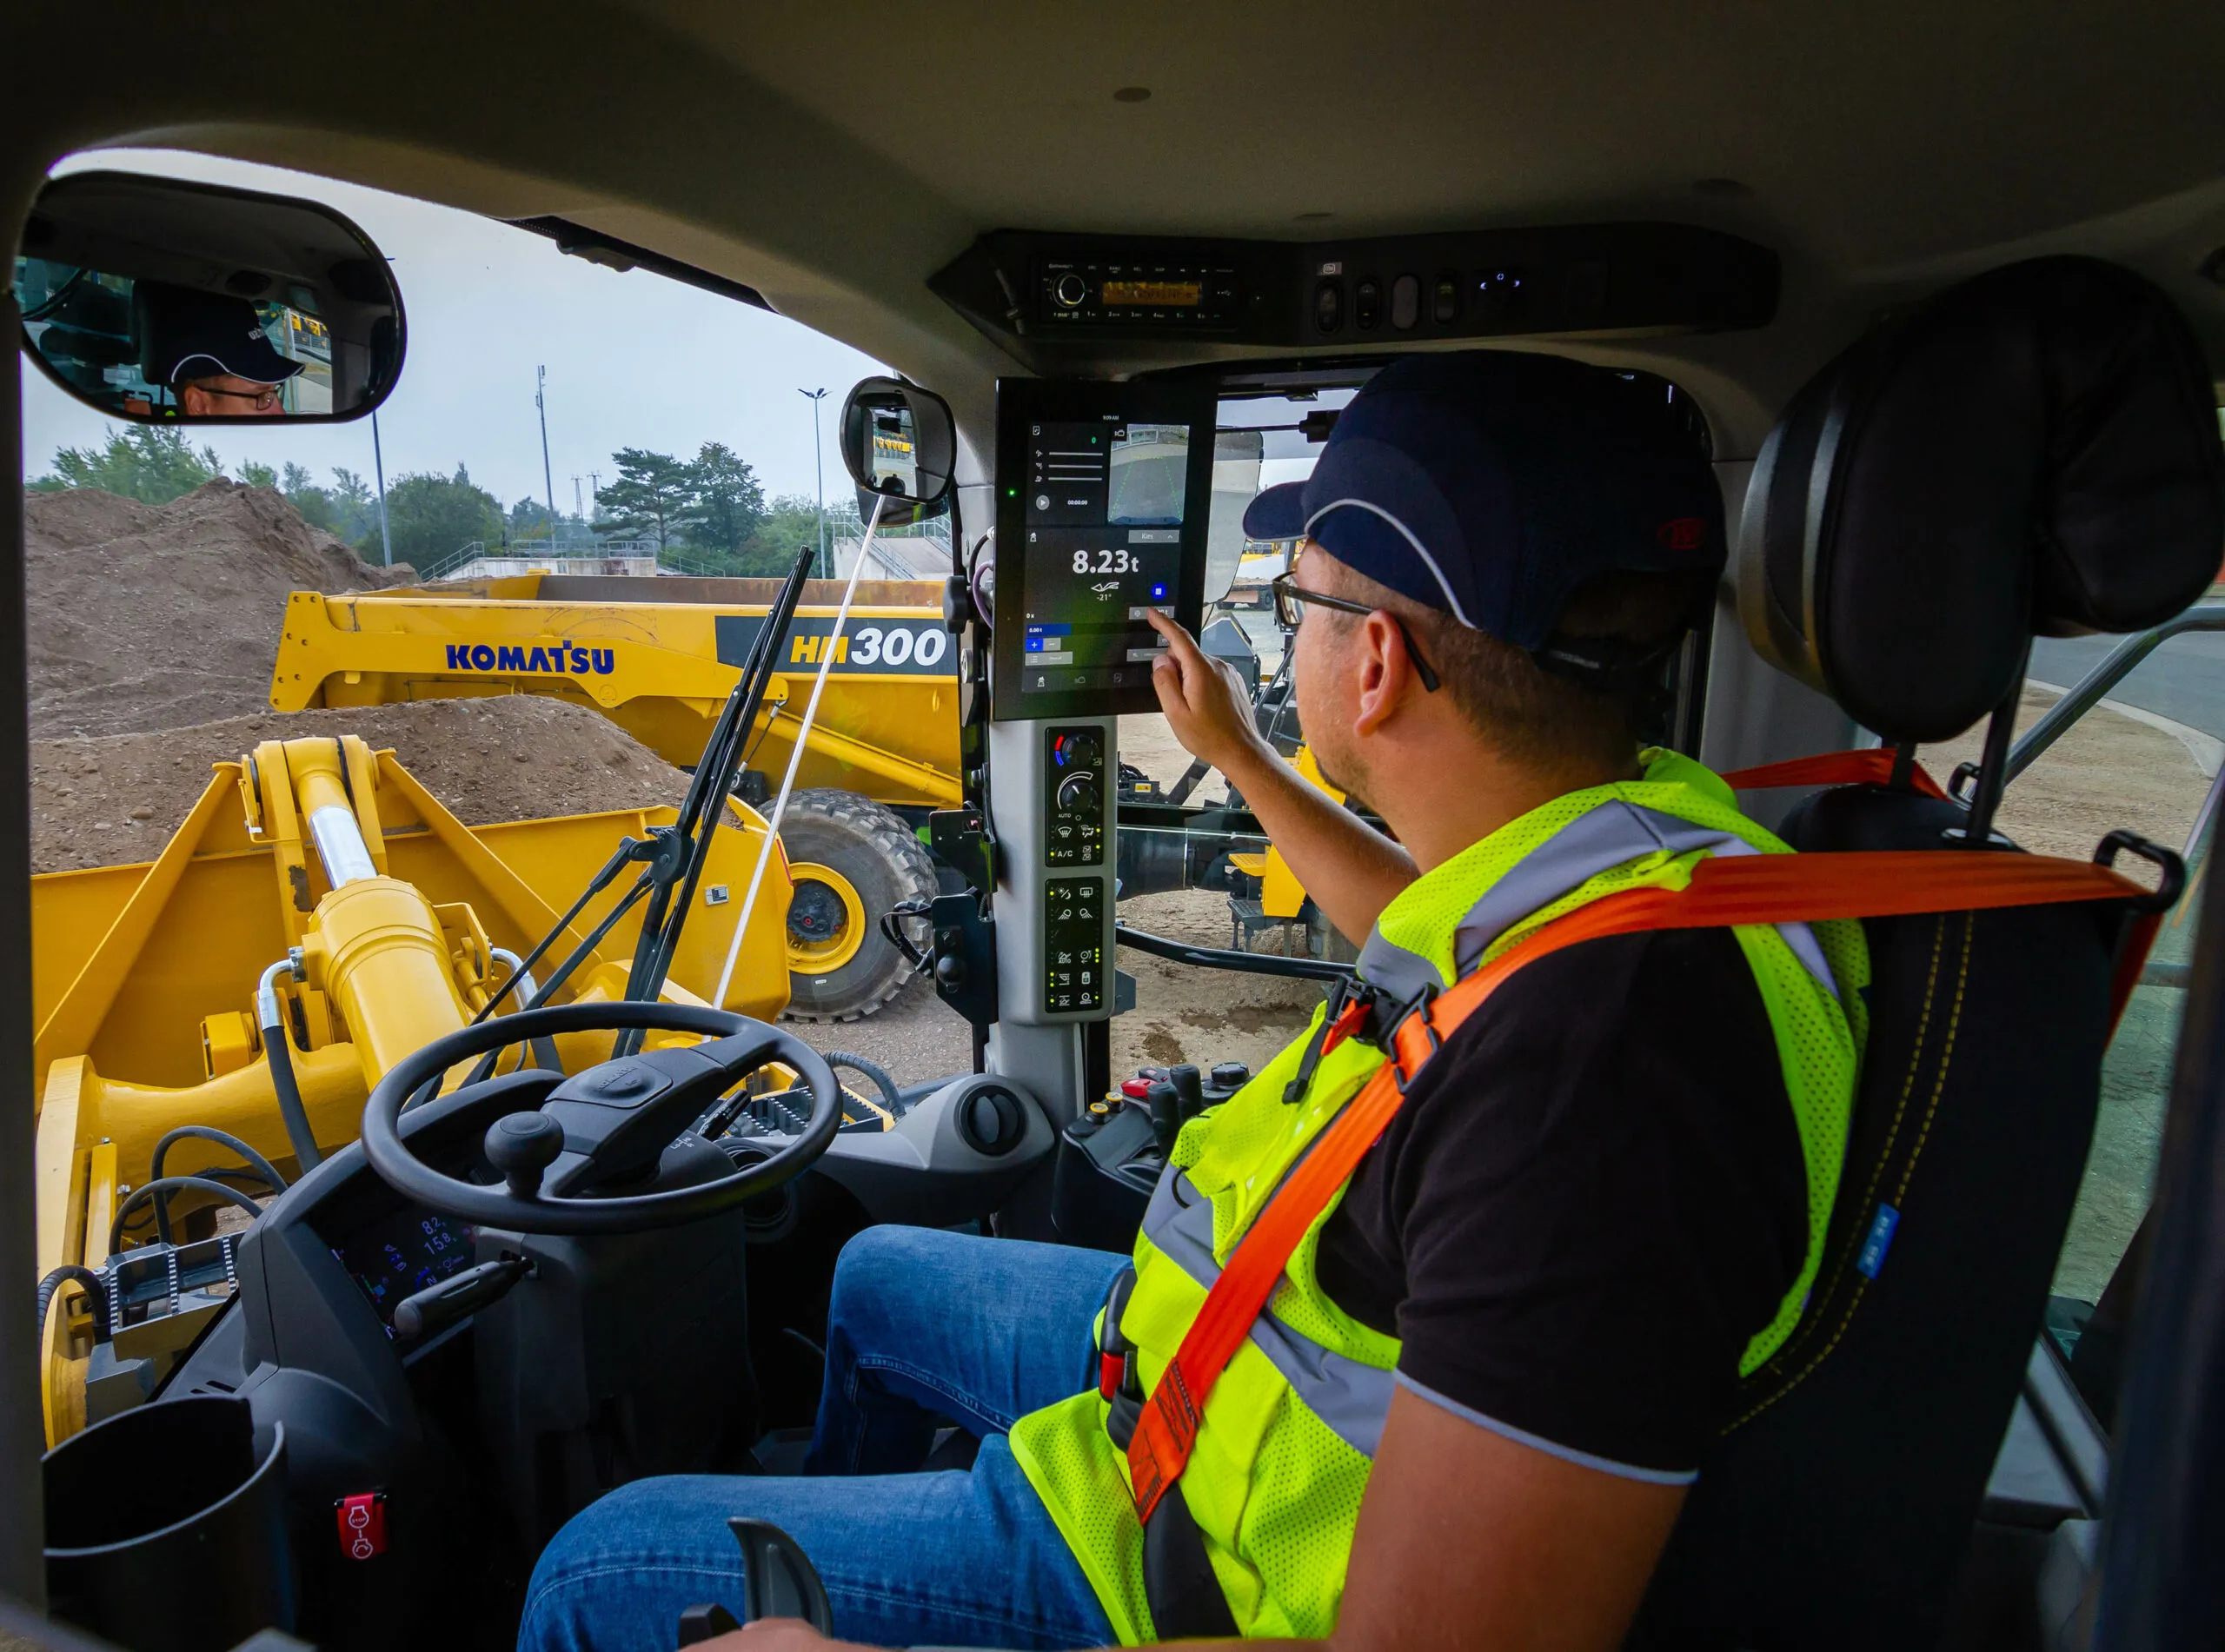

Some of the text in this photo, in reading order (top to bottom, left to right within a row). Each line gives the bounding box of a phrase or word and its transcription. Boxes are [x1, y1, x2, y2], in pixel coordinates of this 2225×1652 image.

[445, 640, 614, 675] KOMATSU
[421, 1217, 442, 1235] 8.2
[424, 1232, 451, 1255] 15.8
